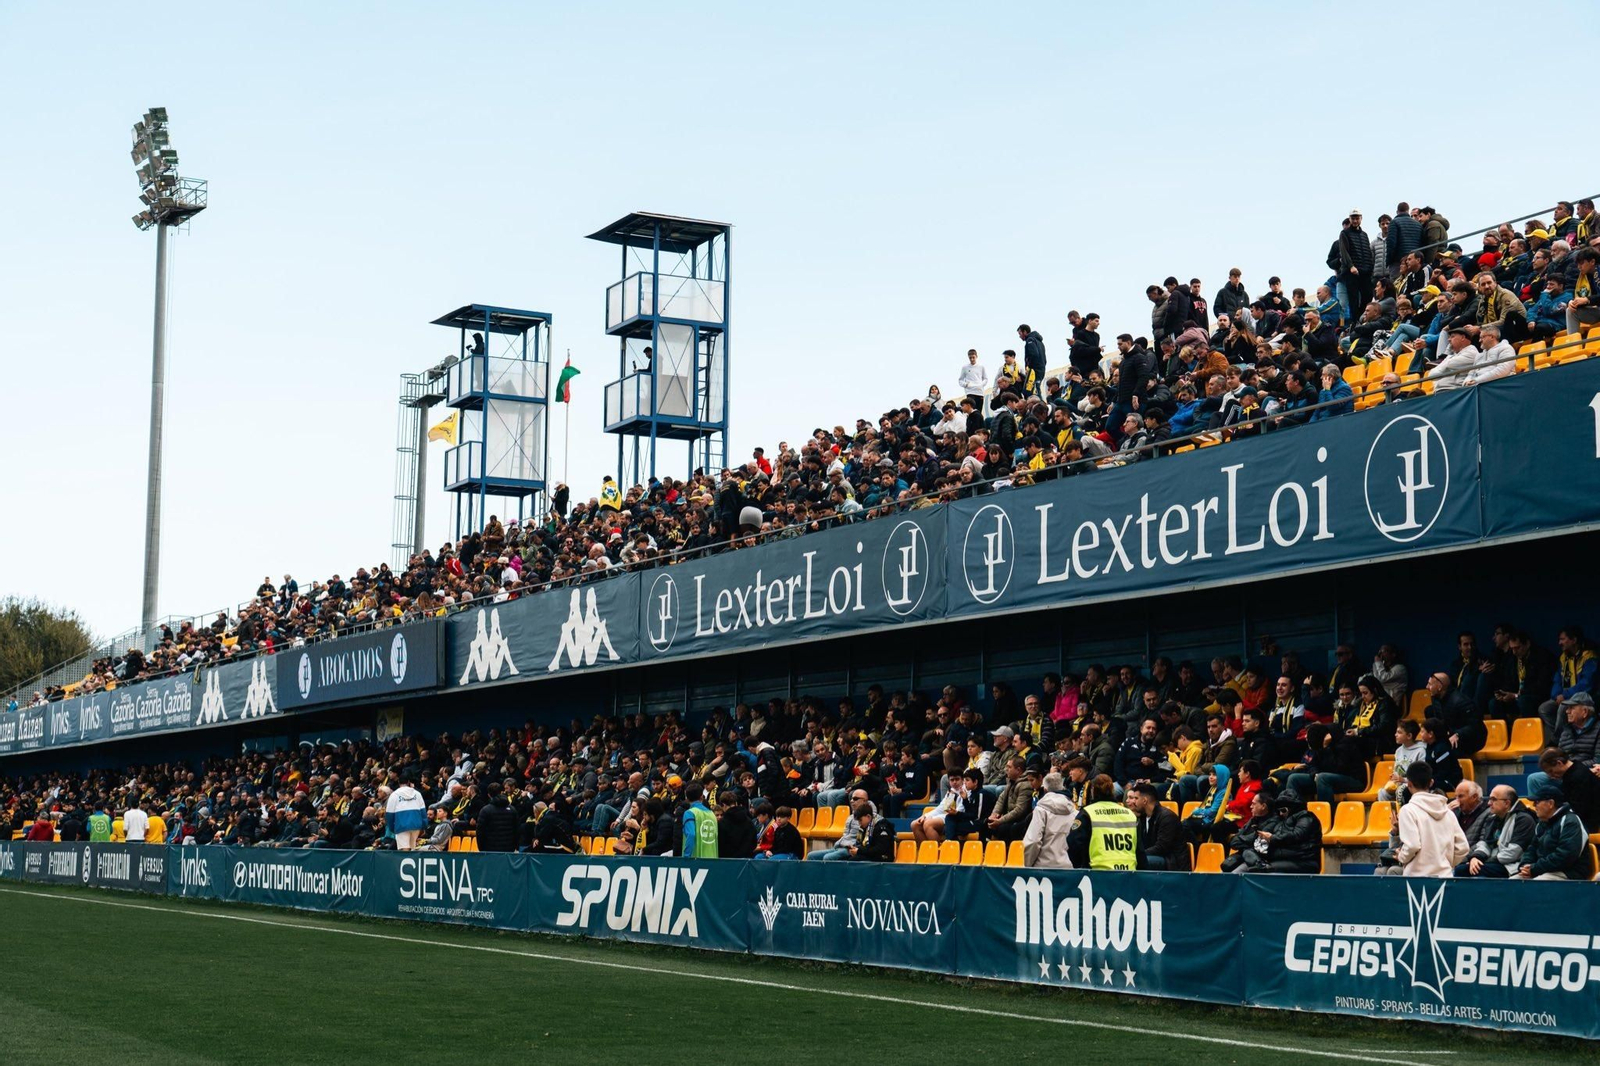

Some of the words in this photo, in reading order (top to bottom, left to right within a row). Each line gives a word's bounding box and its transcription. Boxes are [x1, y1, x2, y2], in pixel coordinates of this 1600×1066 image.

[1036, 446, 1335, 585] LexterLoi
[694, 541, 866, 637] LexterLoi
[317, 645, 383, 688] ABOGADOS
[110, 700, 135, 724] Cazorla
[135, 695, 162, 719] Cazorla
[163, 689, 192, 715] Cazorla
[17, 712, 44, 741] Kaizen
[1103, 833, 1133, 851] NCS
[143, 857, 164, 874] VERSUS
[180, 847, 207, 895] lynks
[248, 862, 295, 892] HYUNDAI
[295, 865, 330, 895] Yuncar
[331, 867, 364, 897] Motor
[399, 857, 475, 903] SIENA
[476, 887, 494, 903] TPC
[556, 864, 709, 938] SPONIX
[786, 892, 808, 909] CAJA
[808, 893, 839, 910] RURAL
[846, 897, 942, 936] NOVANCA
[1012, 875, 1166, 954] Mahou
[802, 909, 825, 928] JAÉN
[1336, 924, 1394, 937] GRUPO
[1284, 921, 1396, 979] CEPISA
[1454, 945, 1588, 993] BEMCO
[1335, 996, 1375, 1011] PINTURAS
[1381, 1000, 1413, 1014] SPRAYS
[1420, 1003, 1451, 1017] BELLAS
[1453, 1006, 1483, 1020] ARTES
[1489, 1009, 1557, 1027] AUTOMOCIÓN
